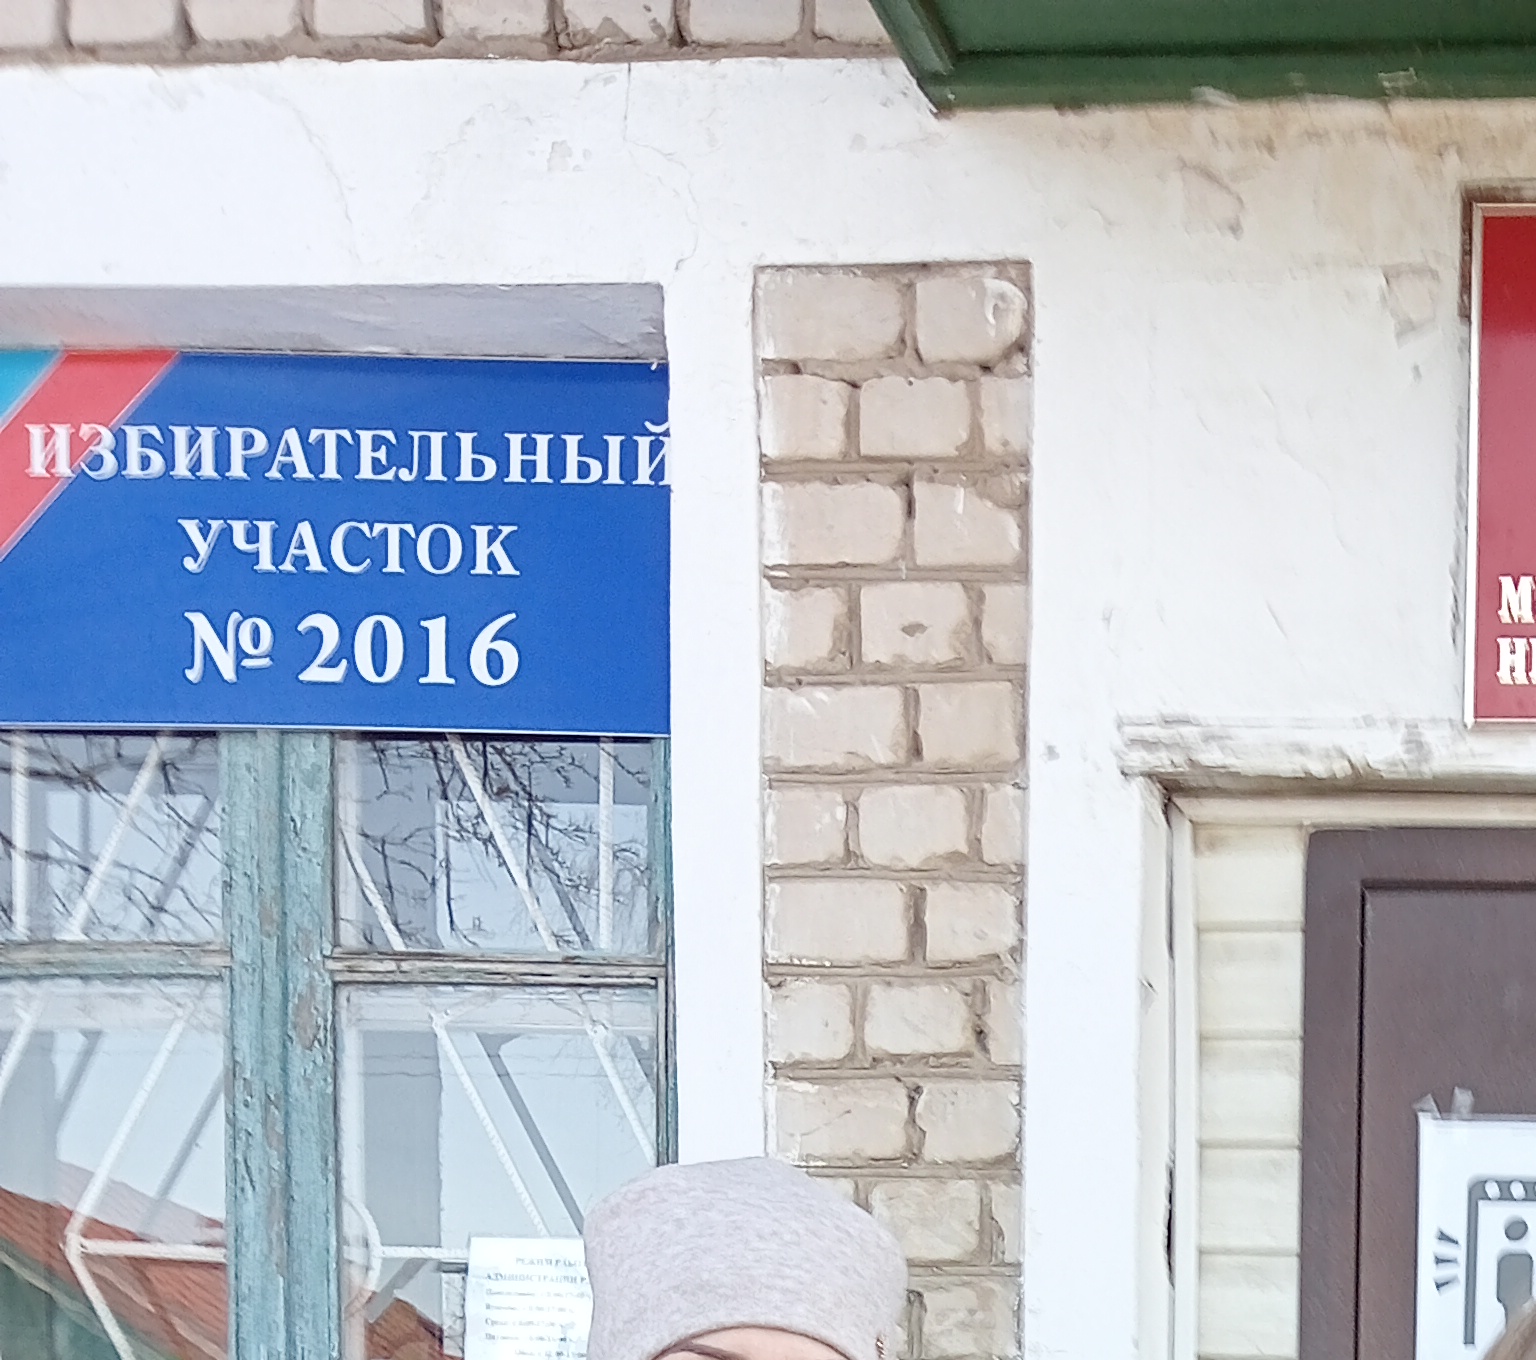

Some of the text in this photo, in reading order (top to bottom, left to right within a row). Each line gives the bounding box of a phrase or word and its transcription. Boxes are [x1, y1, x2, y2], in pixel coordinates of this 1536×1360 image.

[25, 420, 671, 486] ИЗБИРАТЕЛЬНЫЙ
[178, 518, 519, 576] УЧАСТОК
[183, 611, 520, 687] № 2016
